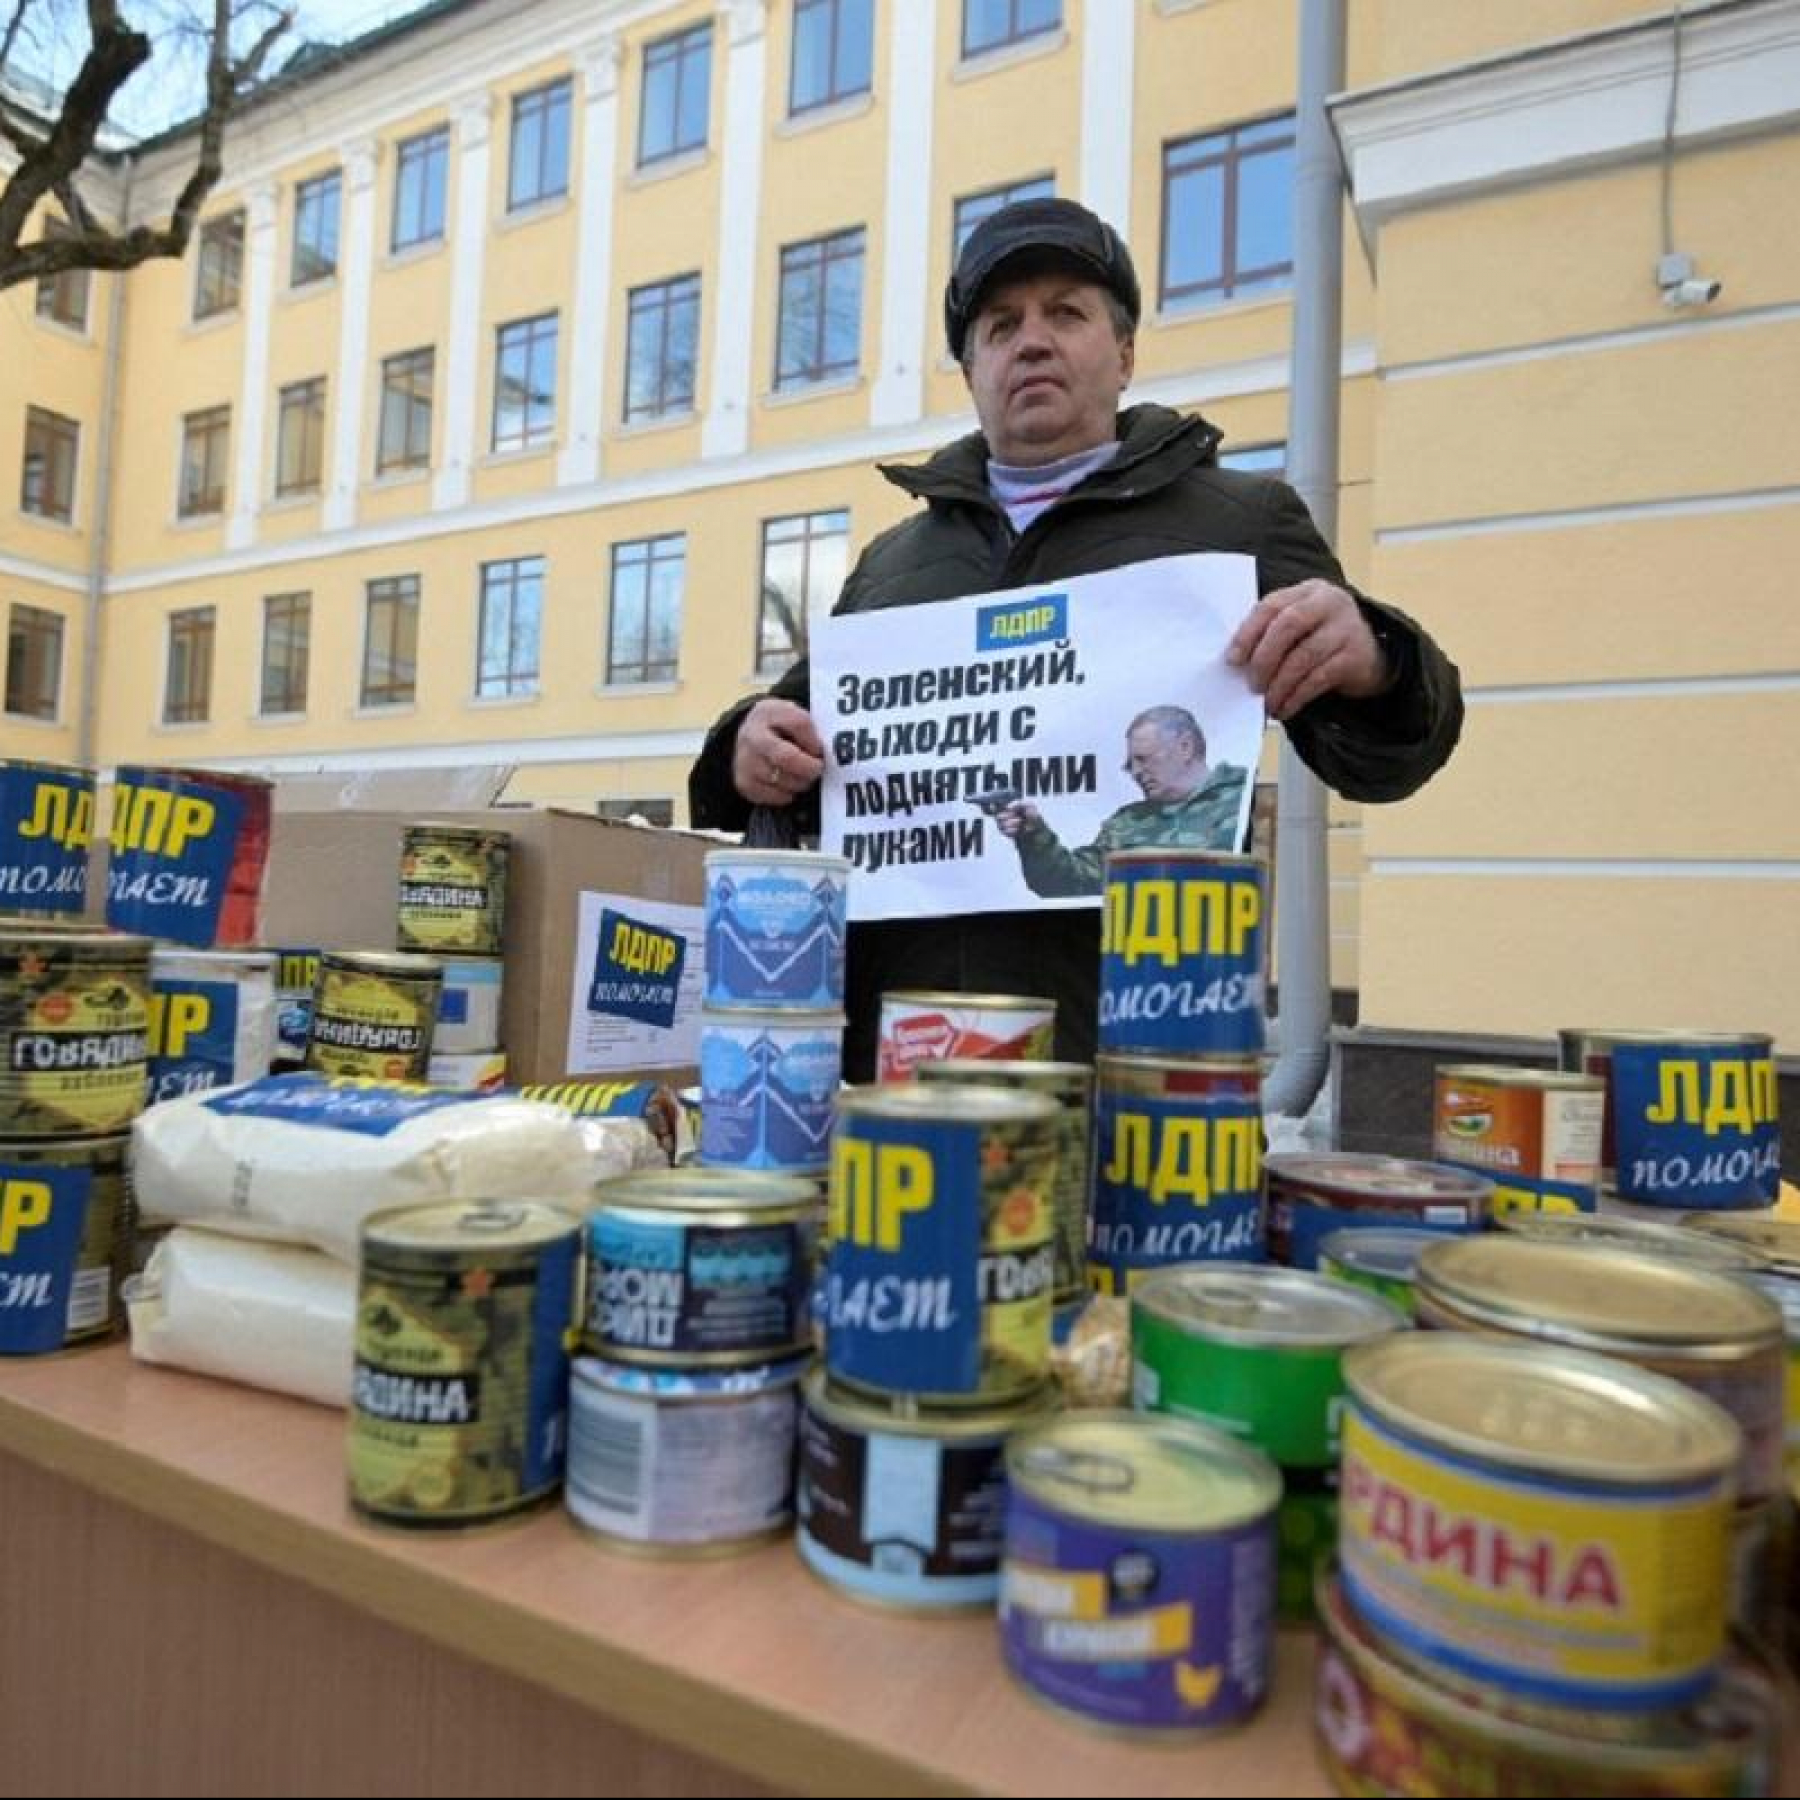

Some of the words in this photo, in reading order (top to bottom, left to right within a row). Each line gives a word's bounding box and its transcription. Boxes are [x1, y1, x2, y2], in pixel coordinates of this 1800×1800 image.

[989, 605, 1057, 641] ЛДПР
[836, 638, 1086, 716] Зеленский,
[833, 710, 1000, 766] выходи
[1010, 705, 1036, 741] с
[844, 754, 1098, 818] поднятыми
[843, 818, 985, 874] руками
[609, 920, 677, 976] ЛДПР
